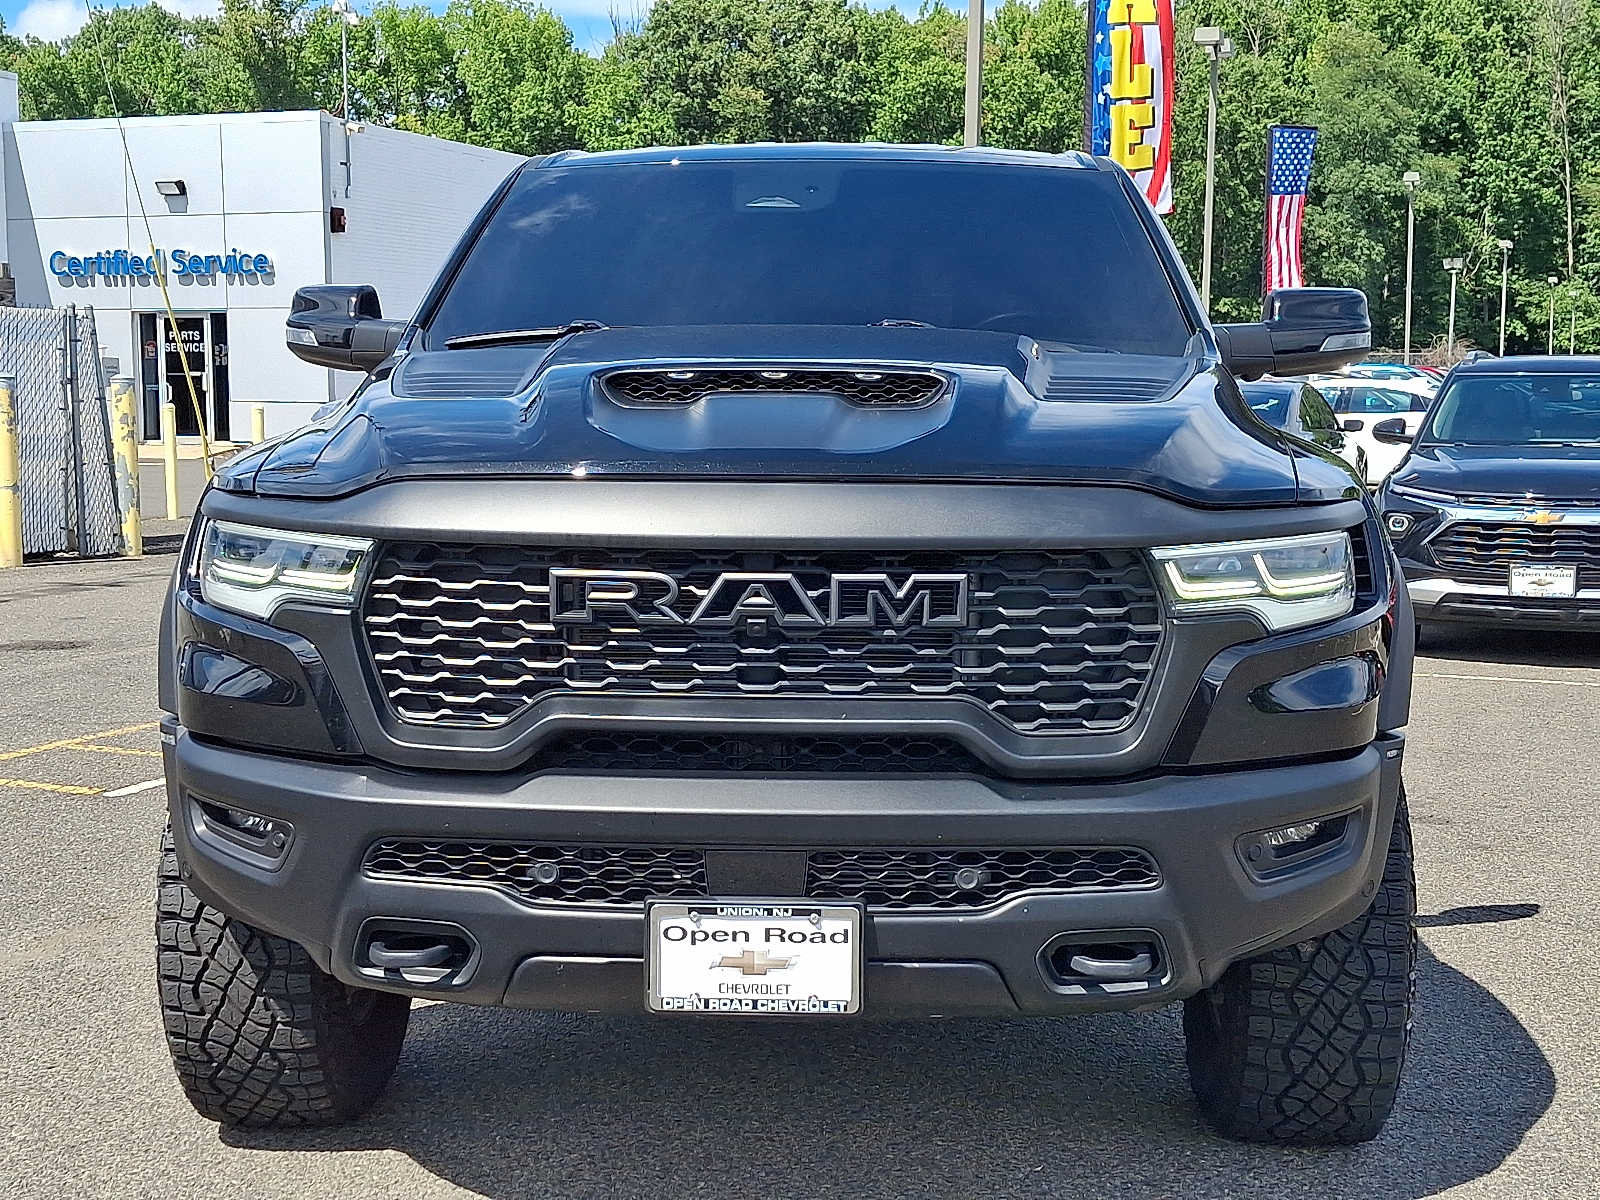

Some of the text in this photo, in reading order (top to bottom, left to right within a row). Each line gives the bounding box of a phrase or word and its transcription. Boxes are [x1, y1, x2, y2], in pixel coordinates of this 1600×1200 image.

[49, 247, 269, 276] Certified Service
[169, 330, 200, 340] PRTS
[549, 567, 969, 625] RAM
[769, 908, 792, 917] NJ
[662, 925, 849, 946] Open Road
[718, 982, 792, 995] CHEVROLET
[662, 997, 849, 1013] OPEN ROAD CHEVROLET
